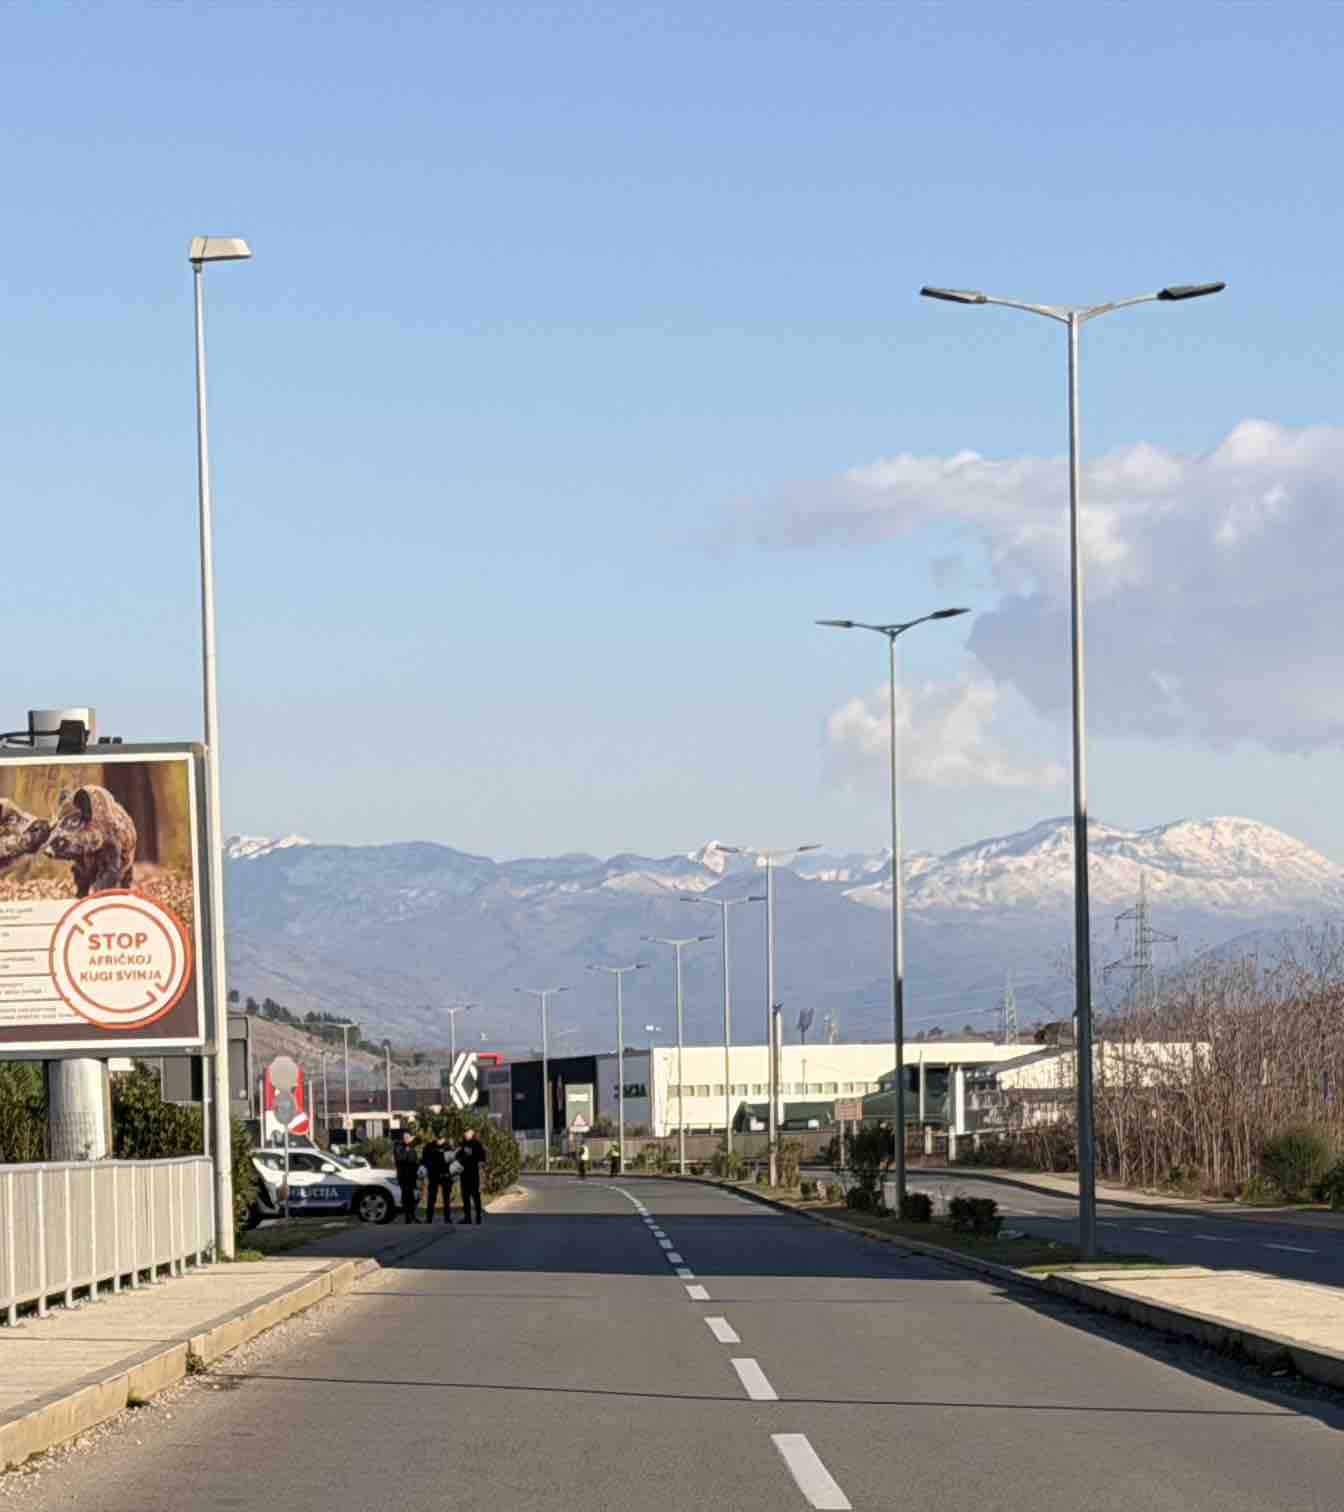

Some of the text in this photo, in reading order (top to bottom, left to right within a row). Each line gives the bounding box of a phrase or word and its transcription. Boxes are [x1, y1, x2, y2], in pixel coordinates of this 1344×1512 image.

[88, 932, 148, 950] STOP
[89, 953, 152, 965] AFRIČKOJ
[80, 969, 162, 981] KUGI SVINJA
